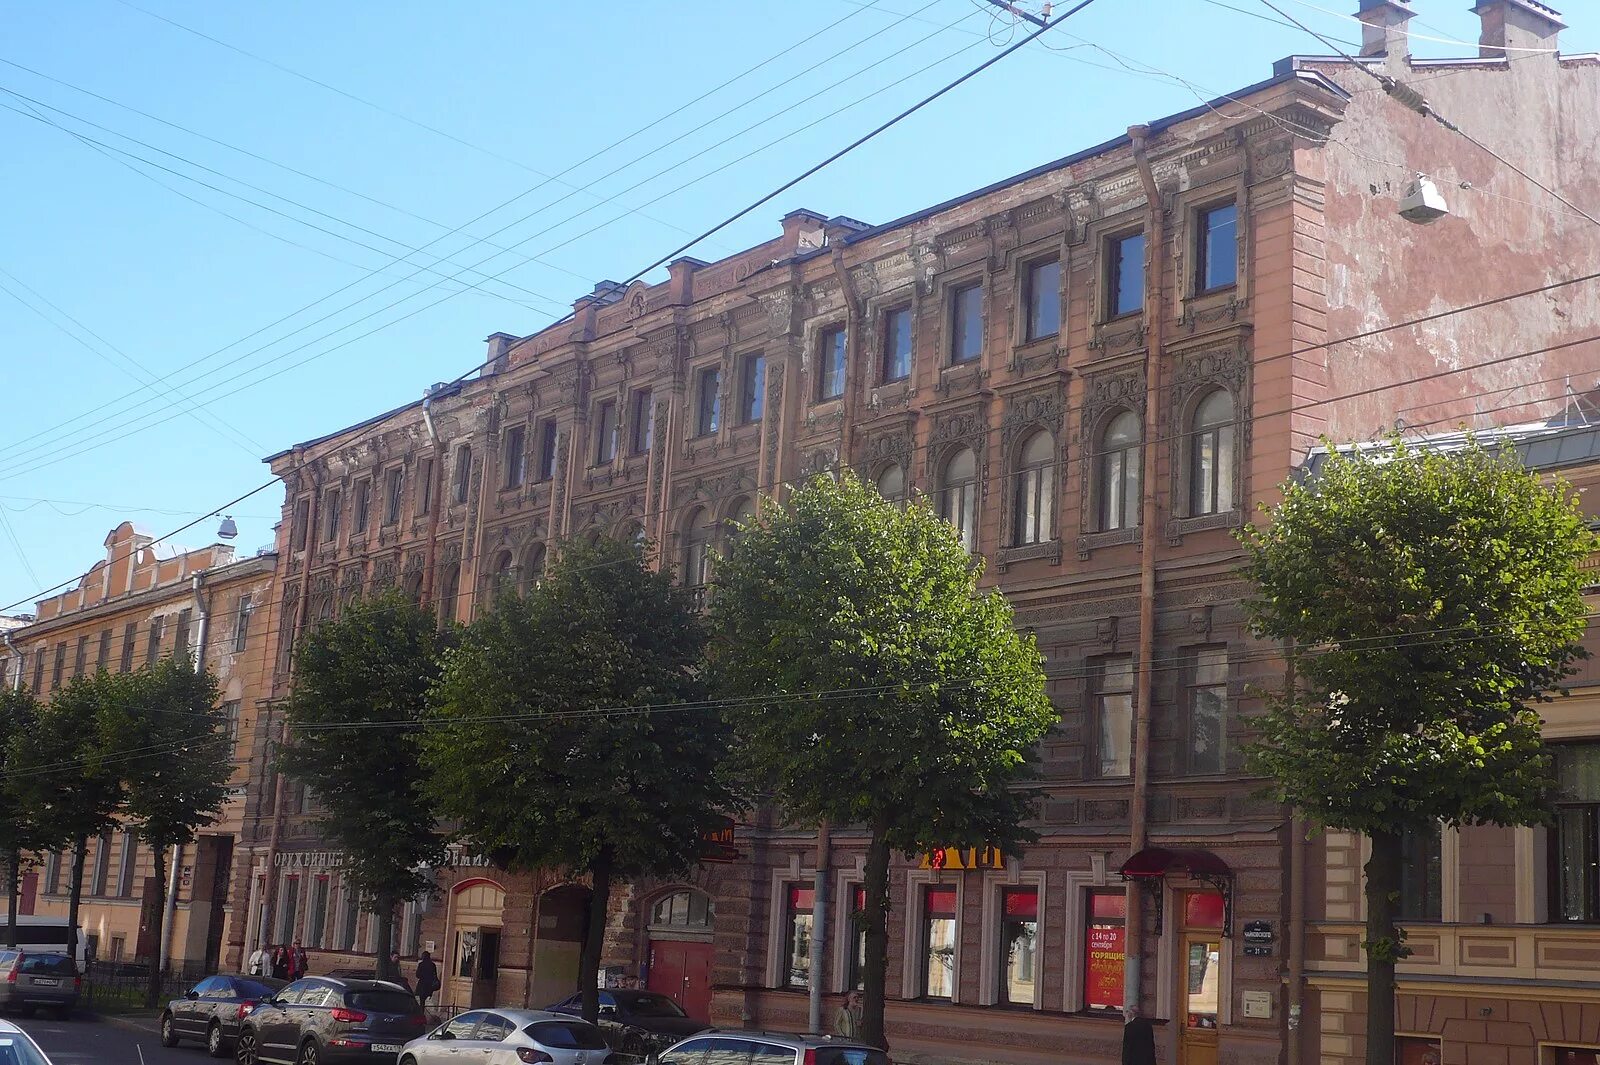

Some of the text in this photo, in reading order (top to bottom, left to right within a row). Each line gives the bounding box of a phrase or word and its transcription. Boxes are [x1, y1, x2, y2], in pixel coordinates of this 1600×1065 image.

[1095, 932, 1102, 940] 14
[1109, 932, 1117, 941] 20
[1091, 941, 1113, 949] сентября
[1091, 951, 1125, 960] ГОРЯЩИЕ
